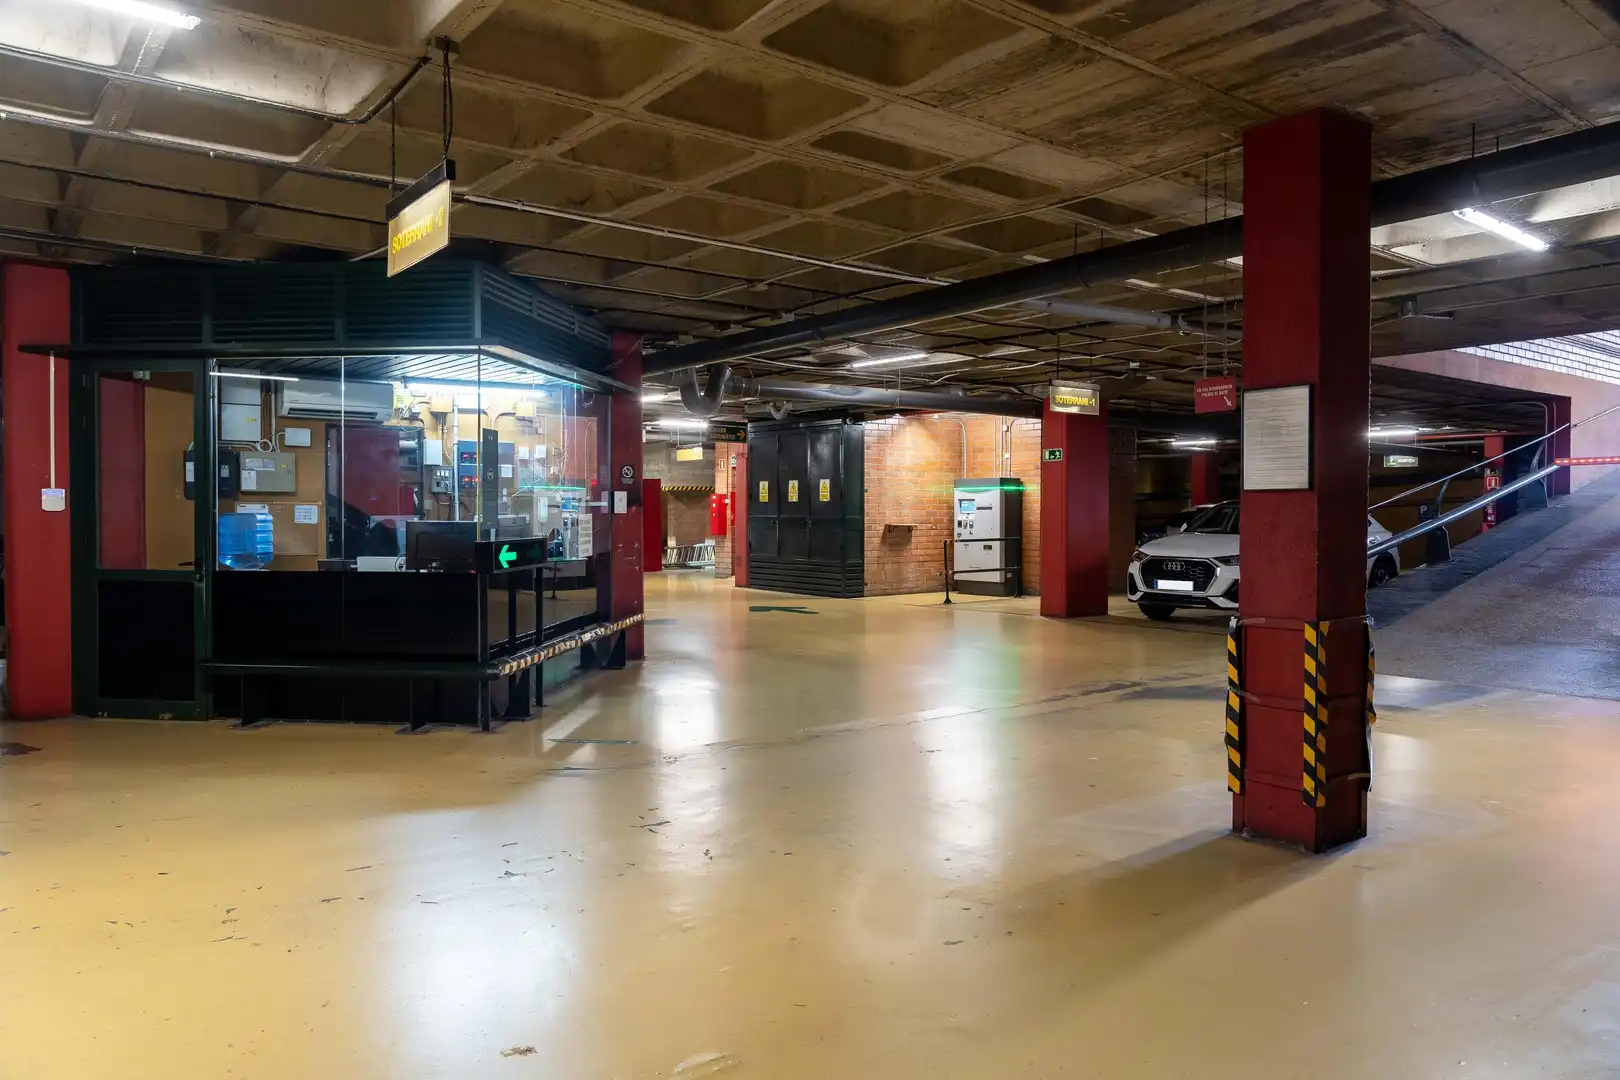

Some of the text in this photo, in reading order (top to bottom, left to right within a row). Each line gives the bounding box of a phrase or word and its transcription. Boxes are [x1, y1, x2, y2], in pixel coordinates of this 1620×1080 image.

[1055, 395, 1096, 407] SOTERRANI -1
[1420, 505, 1428, 514] P
